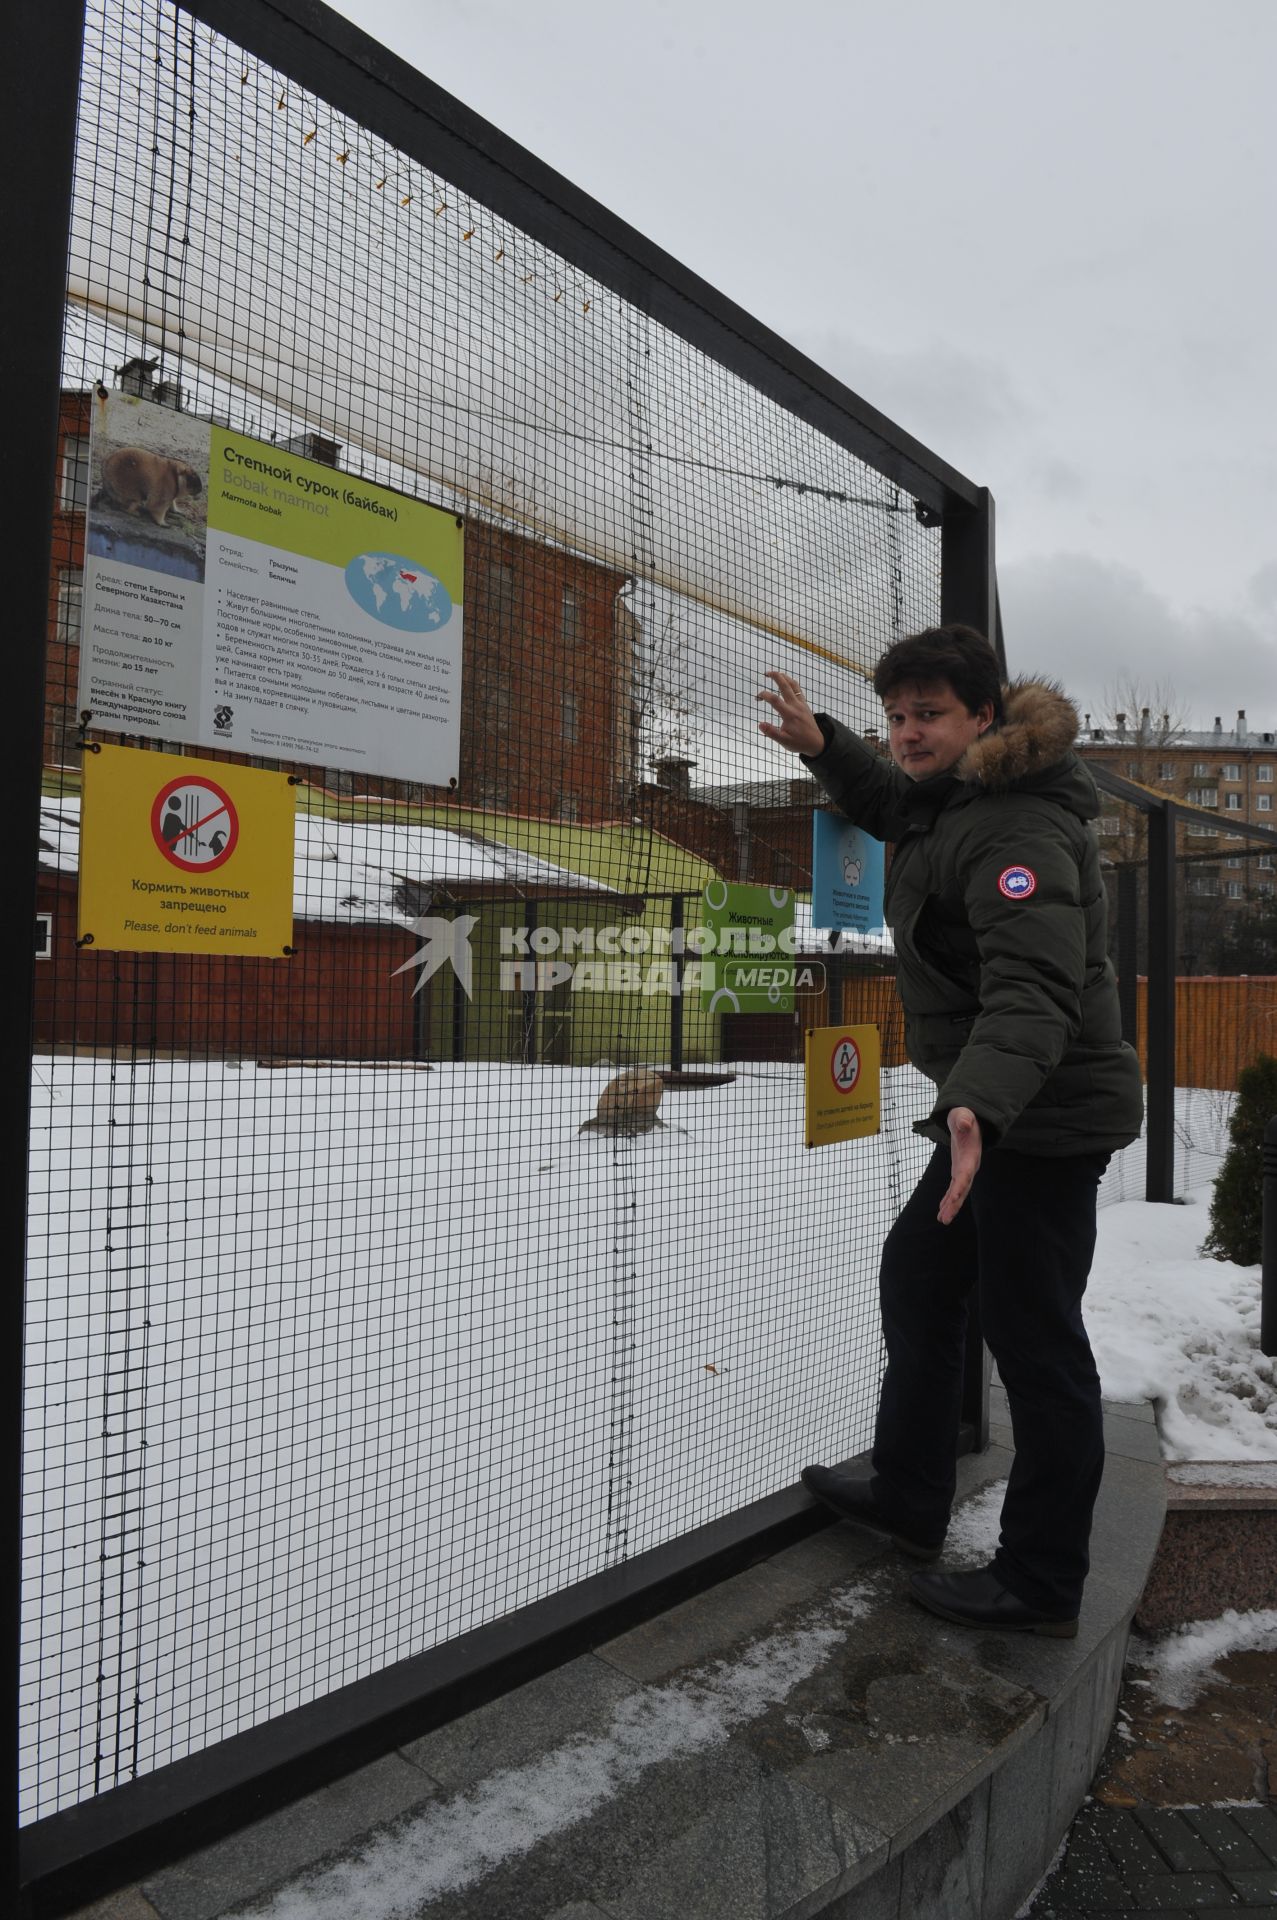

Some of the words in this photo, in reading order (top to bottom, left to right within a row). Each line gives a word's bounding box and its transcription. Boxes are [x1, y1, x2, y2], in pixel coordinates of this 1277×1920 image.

[223, 447, 292, 484] Степной
[297, 476, 339, 500] сурок
[343, 489, 398, 522] (байбак)
[223, 468, 268, 497] Bobak
[273, 488, 329, 517] marmot
[221, 491, 257, 509] Marmota
[259, 501, 282, 517] bobak
[219, 557, 259, 575] Семейство:
[269, 572, 296, 585] Беличьи
[220, 545, 244, 558] Отряд:
[269, 559, 298, 573] Грызуны
[95, 583, 138, 600] Северного
[140, 594, 184, 610] Казахстана
[96, 572, 121, 585] Ареал:
[124, 580, 148, 592] степи
[149, 585, 179, 599] Европы
[94, 603, 120, 616] Длина
[122, 609, 142, 621] тела:
[171, 621, 181, 630] см
[227, 588, 259, 604] Населяет
[261, 600, 299, 614] равнинные
[301, 610, 320, 620] степи.
[93, 624, 119, 637] Масса
[121, 630, 141, 641] тела:
[142, 636, 153, 644] до
[154, 637, 163, 646] 10
[165, 640, 174, 648] кг
[217, 622, 239, 633] ходов
[247, 629, 271, 639] служат
[273, 636, 298, 646] многим
[300, 642, 340, 657] поколениям
[91, 657, 121, 667] жизни:
[121, 662, 132, 670] до
[134, 663, 143, 672] 15
[92, 645, 175, 669] Продолжительность
[215, 655, 229, 663] уже
[232, 659, 265, 671] начинают
[268, 666, 281, 675] есть
[283, 670, 302, 681] траву.
[91, 676, 134, 691] Охранный
[215, 678, 227, 686] вья
[236, 682, 261, 693] злаков,
[263, 688, 310, 703] корневищами
[318, 699, 357, 714] луковицами.
[90, 687, 119, 699] внесён
[128, 693, 163, 707] Красную
[164, 701, 187, 711] книгу
[90, 697, 161, 716] Международного
[163, 711, 187, 721] союза
[223, 690, 232, 698] На
[235, 693, 252, 703] зиму
[254, 697, 278, 707] падает
[286, 703, 309, 715] спячку.
[123, 714, 160, 727] природы.
[132, 879, 186, 894] Кормить
[190, 886, 249, 899] животных
[160, 900, 226, 913] запрещено
[729, 912, 773, 926] Животные
[124, 920, 160, 933] Please,
[165, 923, 192, 934] don't
[194, 924, 217, 935] feed
[219, 927, 257, 938] animals
